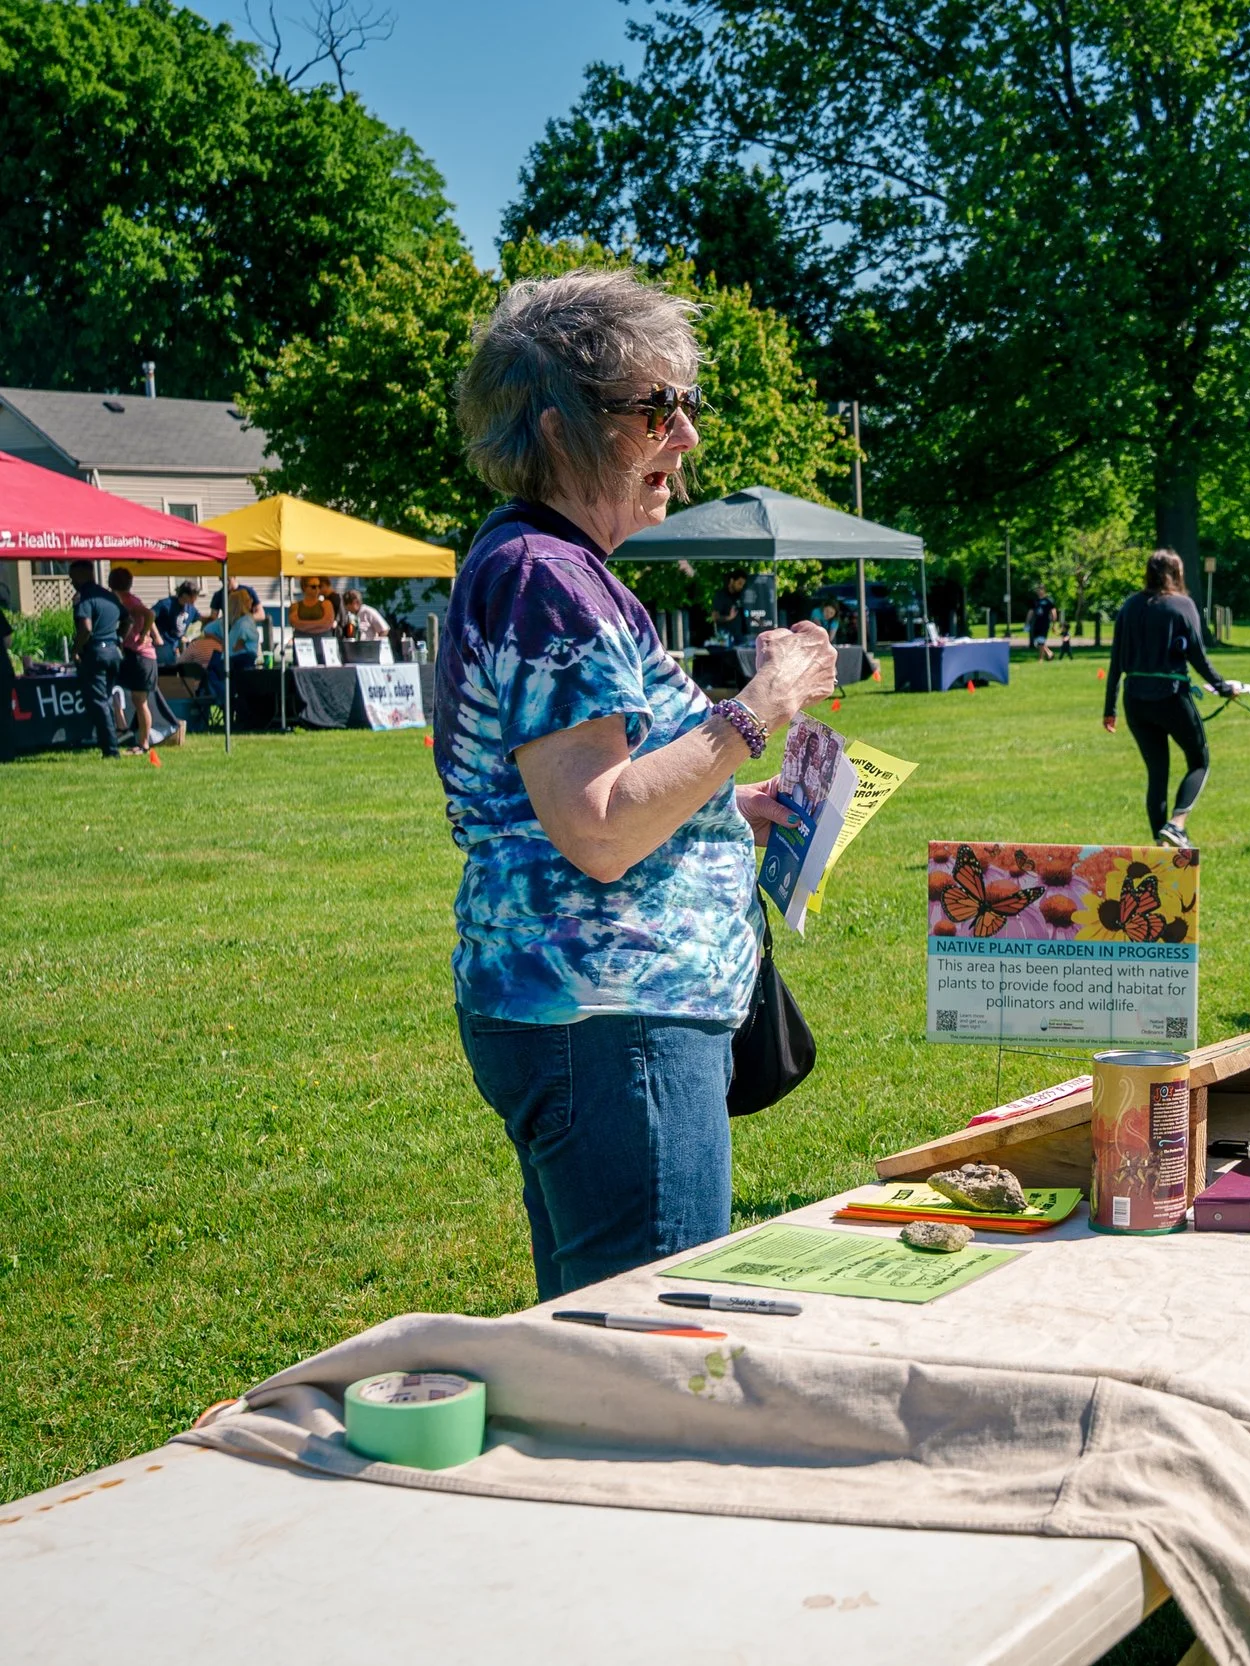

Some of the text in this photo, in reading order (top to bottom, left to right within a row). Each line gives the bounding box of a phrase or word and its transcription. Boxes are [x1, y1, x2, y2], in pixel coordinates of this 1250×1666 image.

[18, 531, 61, 549] Health
[71, 536, 93, 549] Mary
[95, 537, 102, 548] &
[103, 535, 142, 548] Elizabeth
[36, 684, 87, 718] Hea
[849, 757, 868, 766] WHY
[863, 761, 883, 778] BUY
[937, 940, 1190, 959] NATIVE PLANT GARDEN IN PROGRESS
[937, 958, 1190, 979] This area has been planted with native
[938, 976, 1187, 996] plants to provide food and habitat for
[986, 995, 1137, 1012] pollinators and wildlife.
